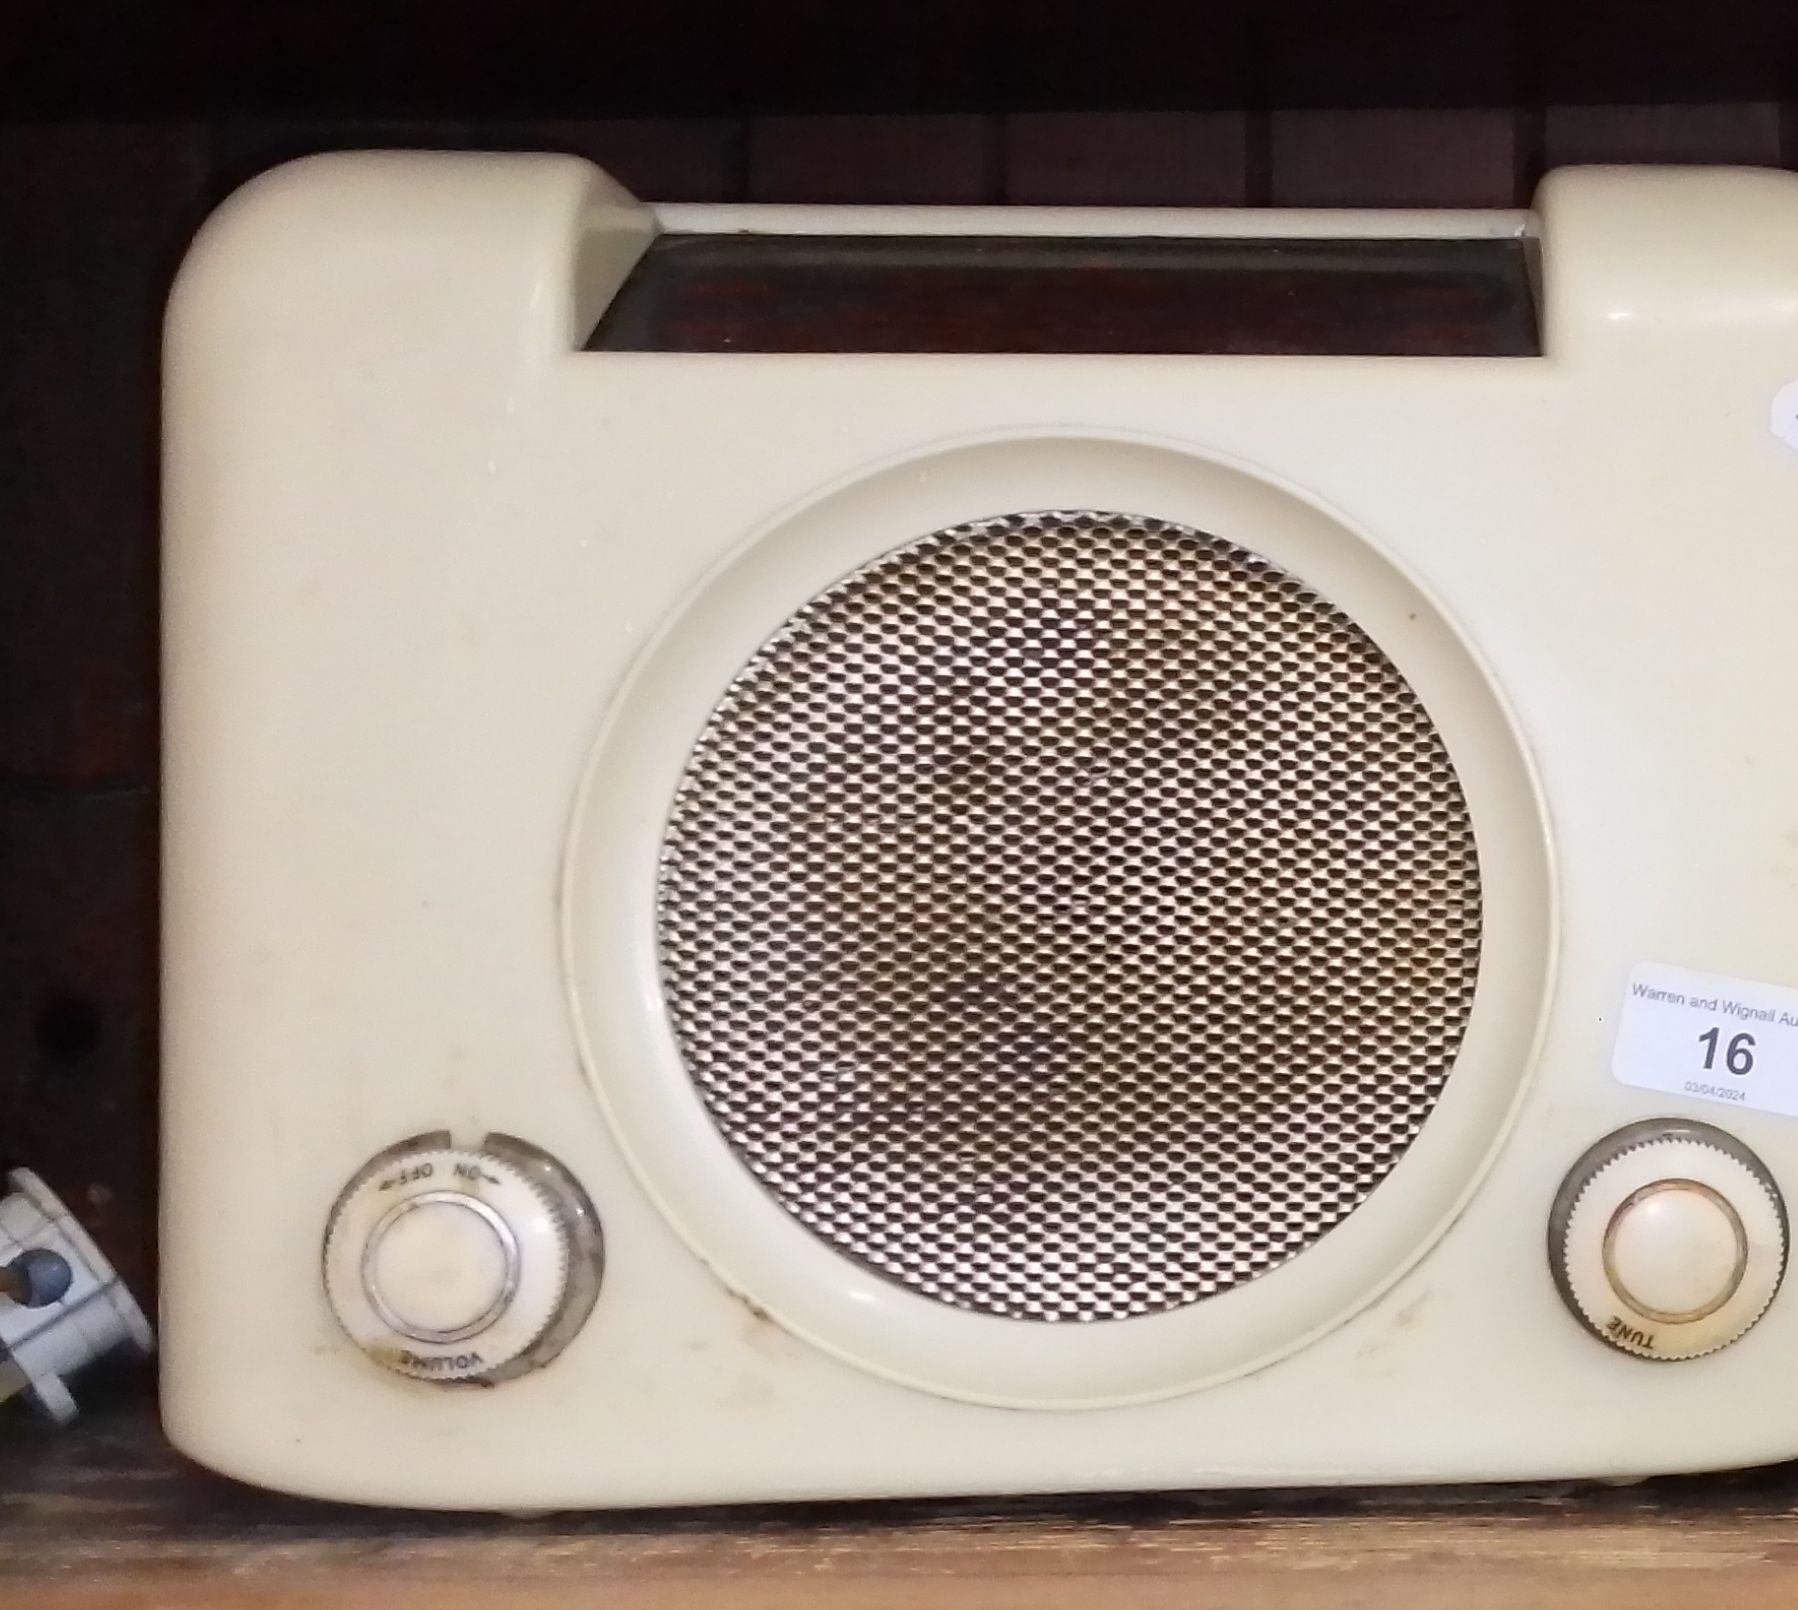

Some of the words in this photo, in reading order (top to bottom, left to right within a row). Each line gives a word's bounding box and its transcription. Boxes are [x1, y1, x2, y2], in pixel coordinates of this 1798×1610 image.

[1631, 981, 1686, 1007] Warren
[1689, 994, 1718, 1012] and
[1722, 999, 1776, 1025] Wignall
[1697, 1025, 1757, 1077] 16
[399, 1161, 434, 1186] OFF
[452, 1161, 483, 1181] ON
[1604, 1314, 1656, 1351] TUNE
[399, 1349, 485, 1372] VOLUME
